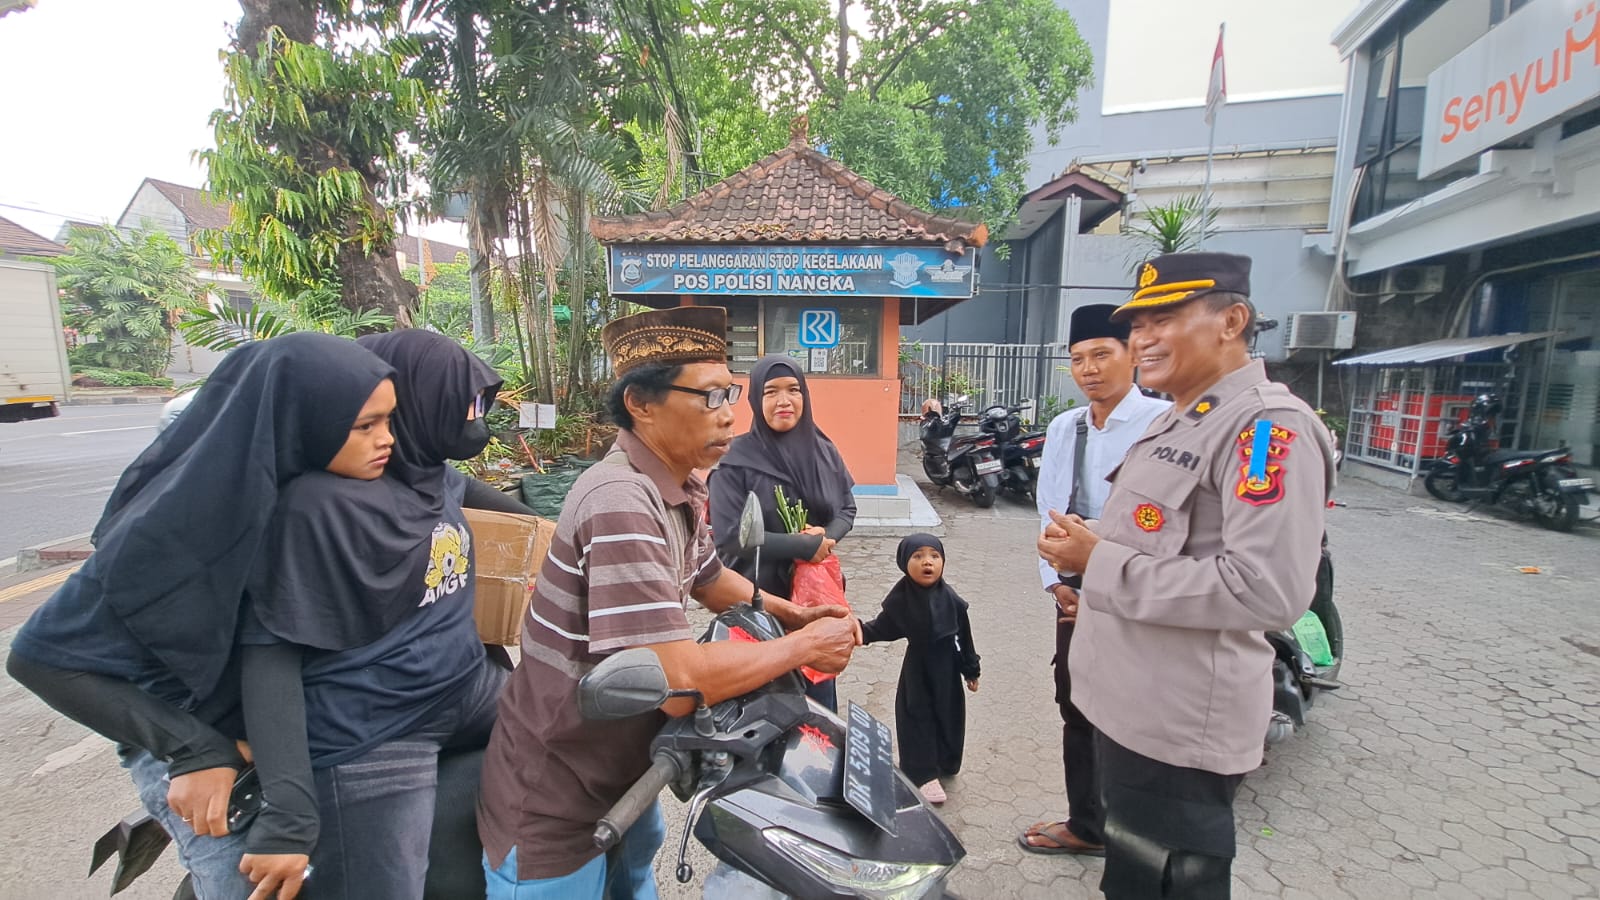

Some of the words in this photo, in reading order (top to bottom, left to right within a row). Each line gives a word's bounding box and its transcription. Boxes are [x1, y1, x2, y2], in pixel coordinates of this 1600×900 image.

[646, 253, 676, 268] STOP
[679, 253, 766, 269] PELANGGARAN
[768, 253, 799, 269] STOP
[802, 254, 883, 270] KECELAKAAN
[673, 274, 709, 290] POS
[714, 274, 772, 290] POLISI
[778, 275, 855, 291] NANGKA
[849, 727, 871, 776] 5209
[848, 774, 872, 815] DK
